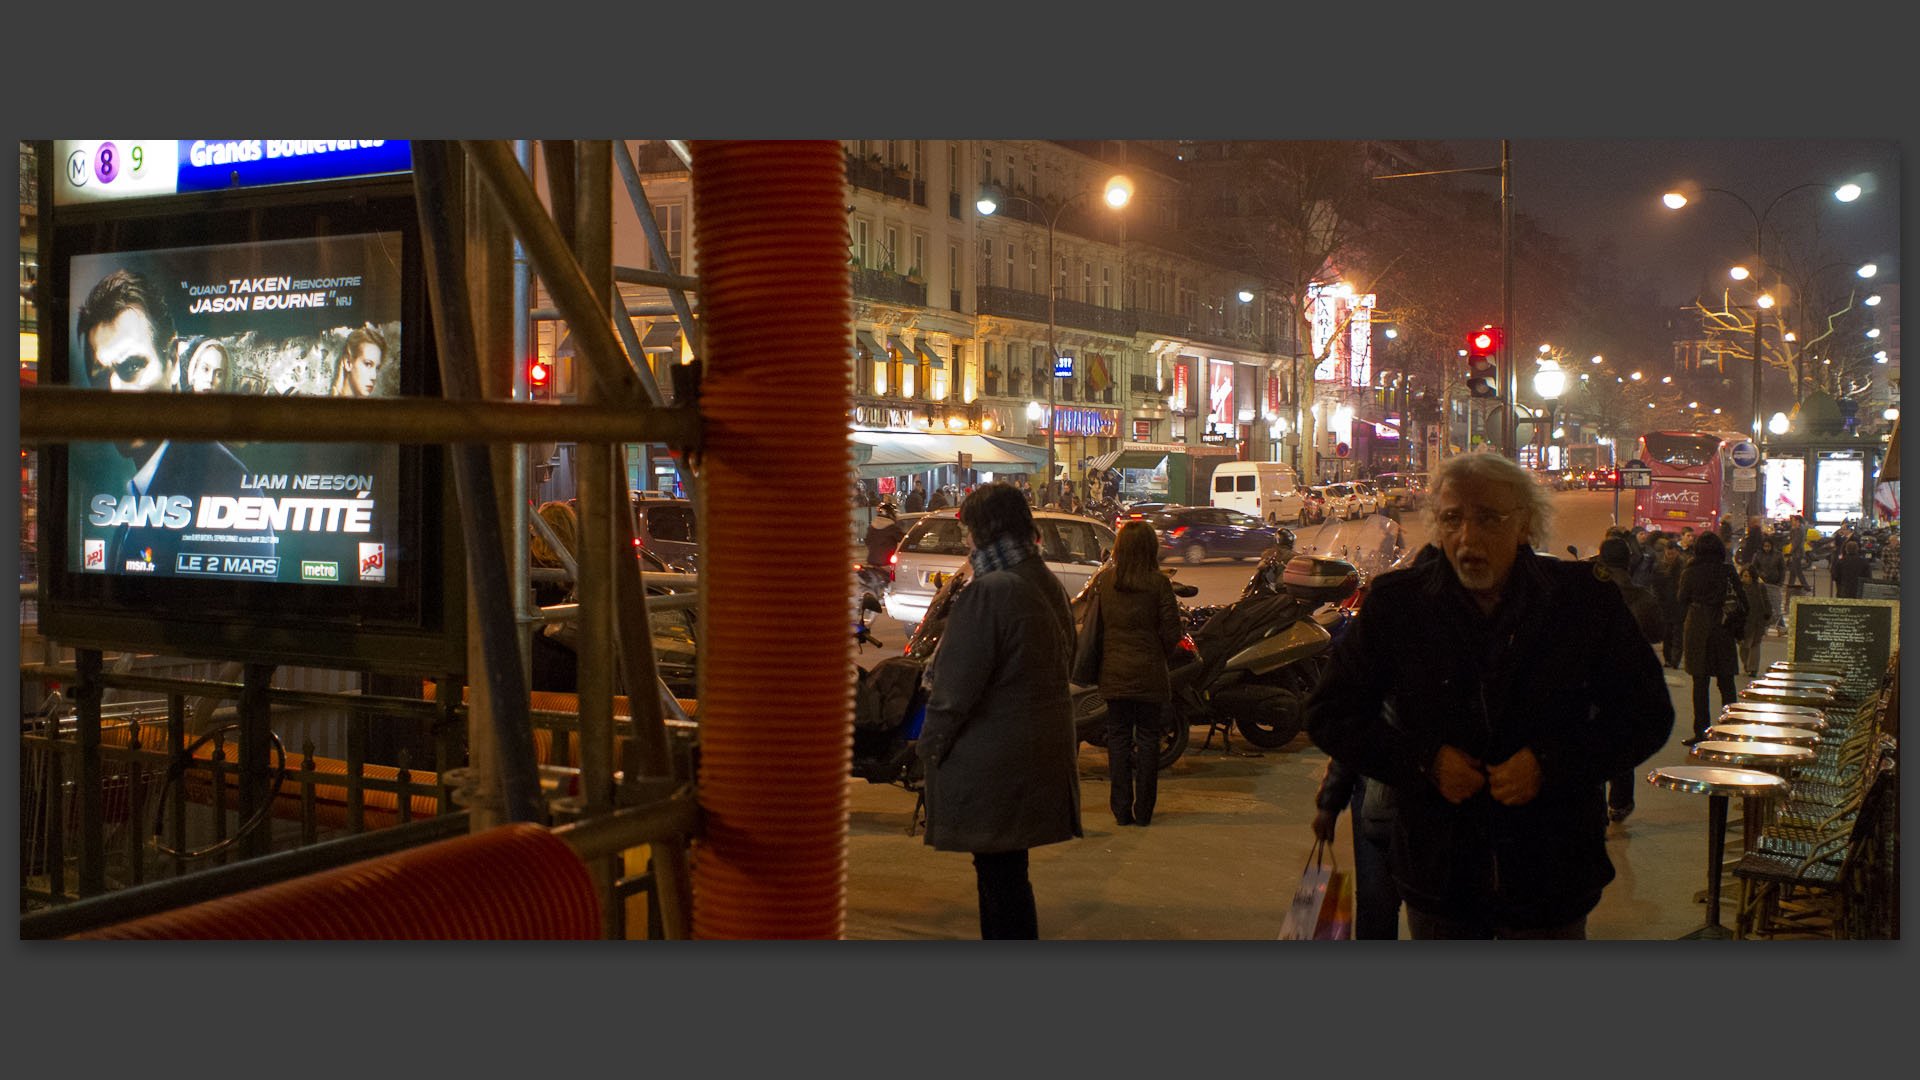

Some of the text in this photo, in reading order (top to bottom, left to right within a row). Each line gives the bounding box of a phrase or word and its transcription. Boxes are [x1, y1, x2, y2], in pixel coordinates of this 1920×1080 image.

[100, 148, 113, 176] 8
[131, 145, 144, 172] 9
[190, 139, 386, 167] Grands Bouleva
[229, 276, 291, 294] TAKEN
[292, 276, 362, 290] RENCONTRE
[189, 296, 248, 314] JASON
[240, 474, 373, 490] LIAM NEESON
[89, 491, 374, 532] SANS IDENTITÉ
[126, 560, 156, 572] msn.fr
[178, 556, 277, 574] LE 2 MARS
[304, 564, 336, 577] metro
